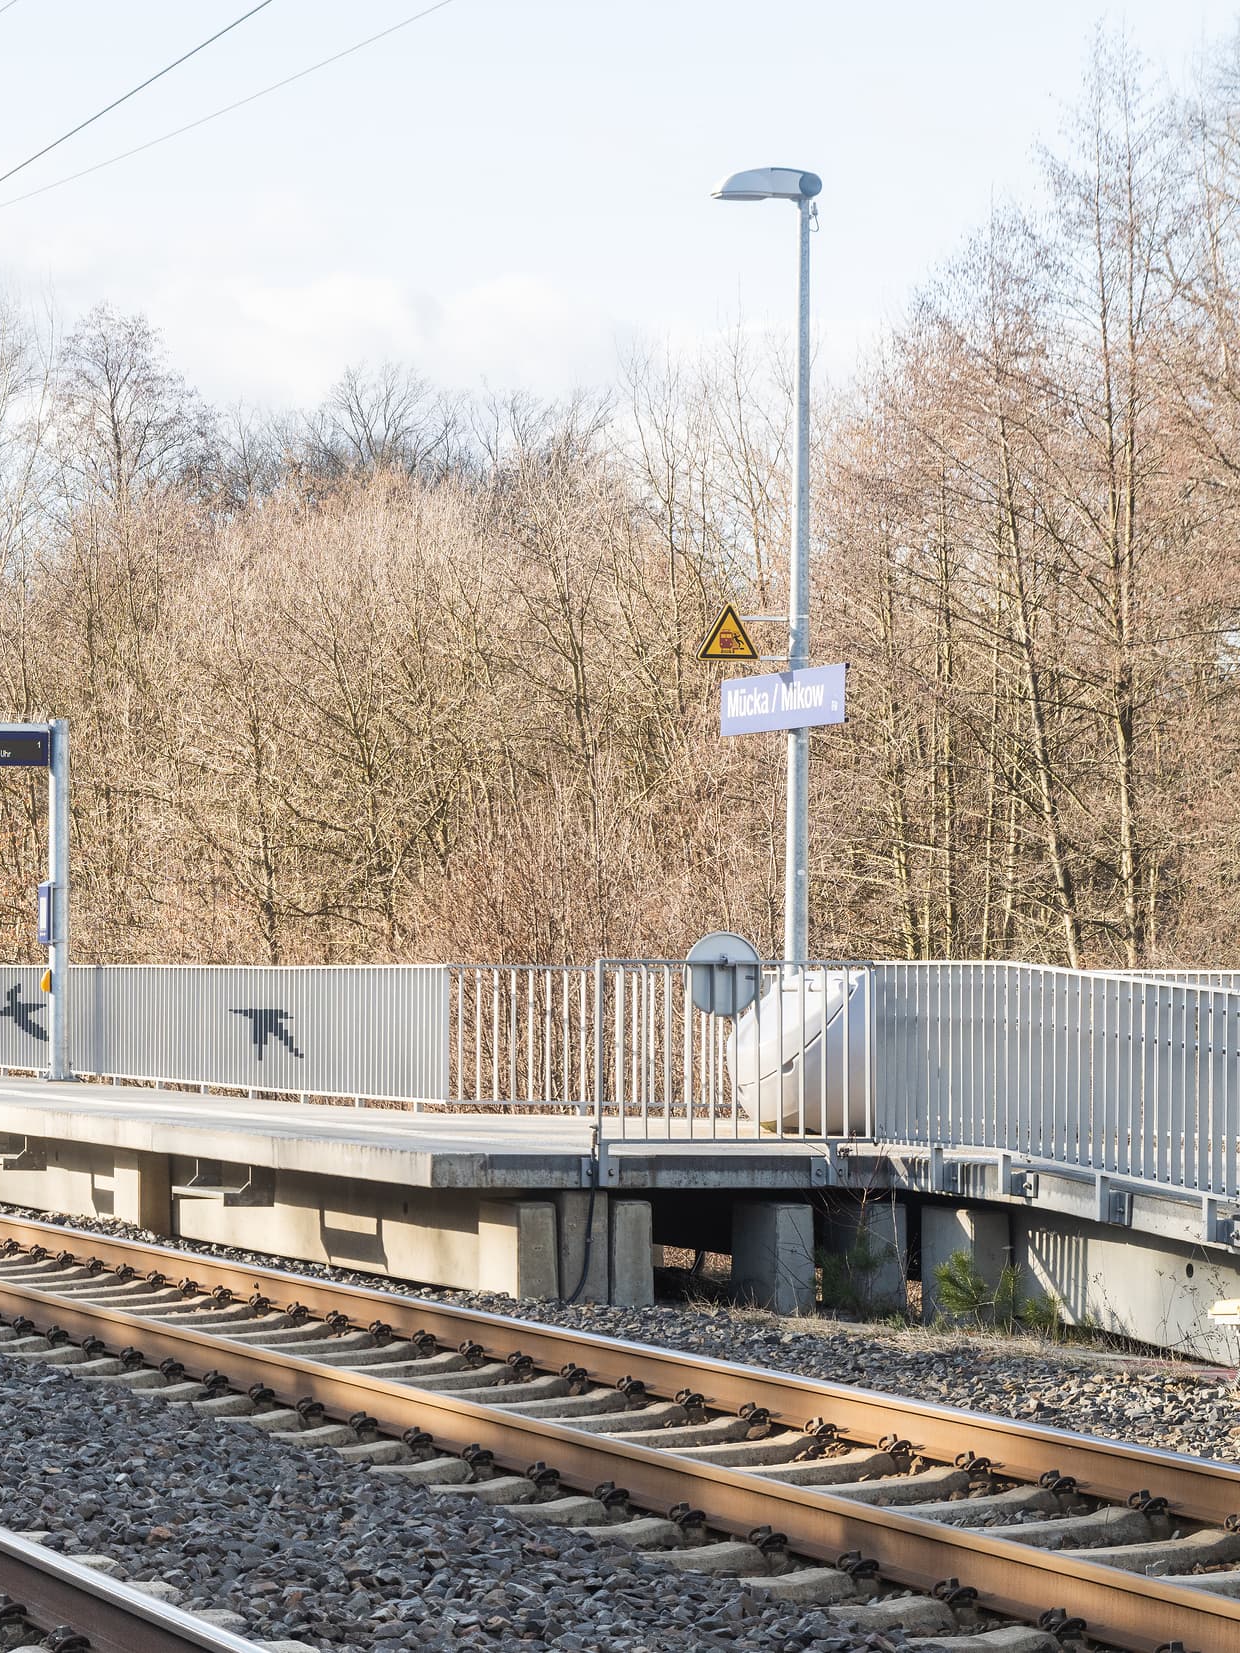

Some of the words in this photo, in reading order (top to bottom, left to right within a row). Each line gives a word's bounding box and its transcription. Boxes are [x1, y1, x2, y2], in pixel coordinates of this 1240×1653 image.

[727, 687, 769, 718] Mücka
[771, 683, 779, 713] /
[781, 681, 825, 712] Mikow
[0, 749, 11, 758] Uhr
